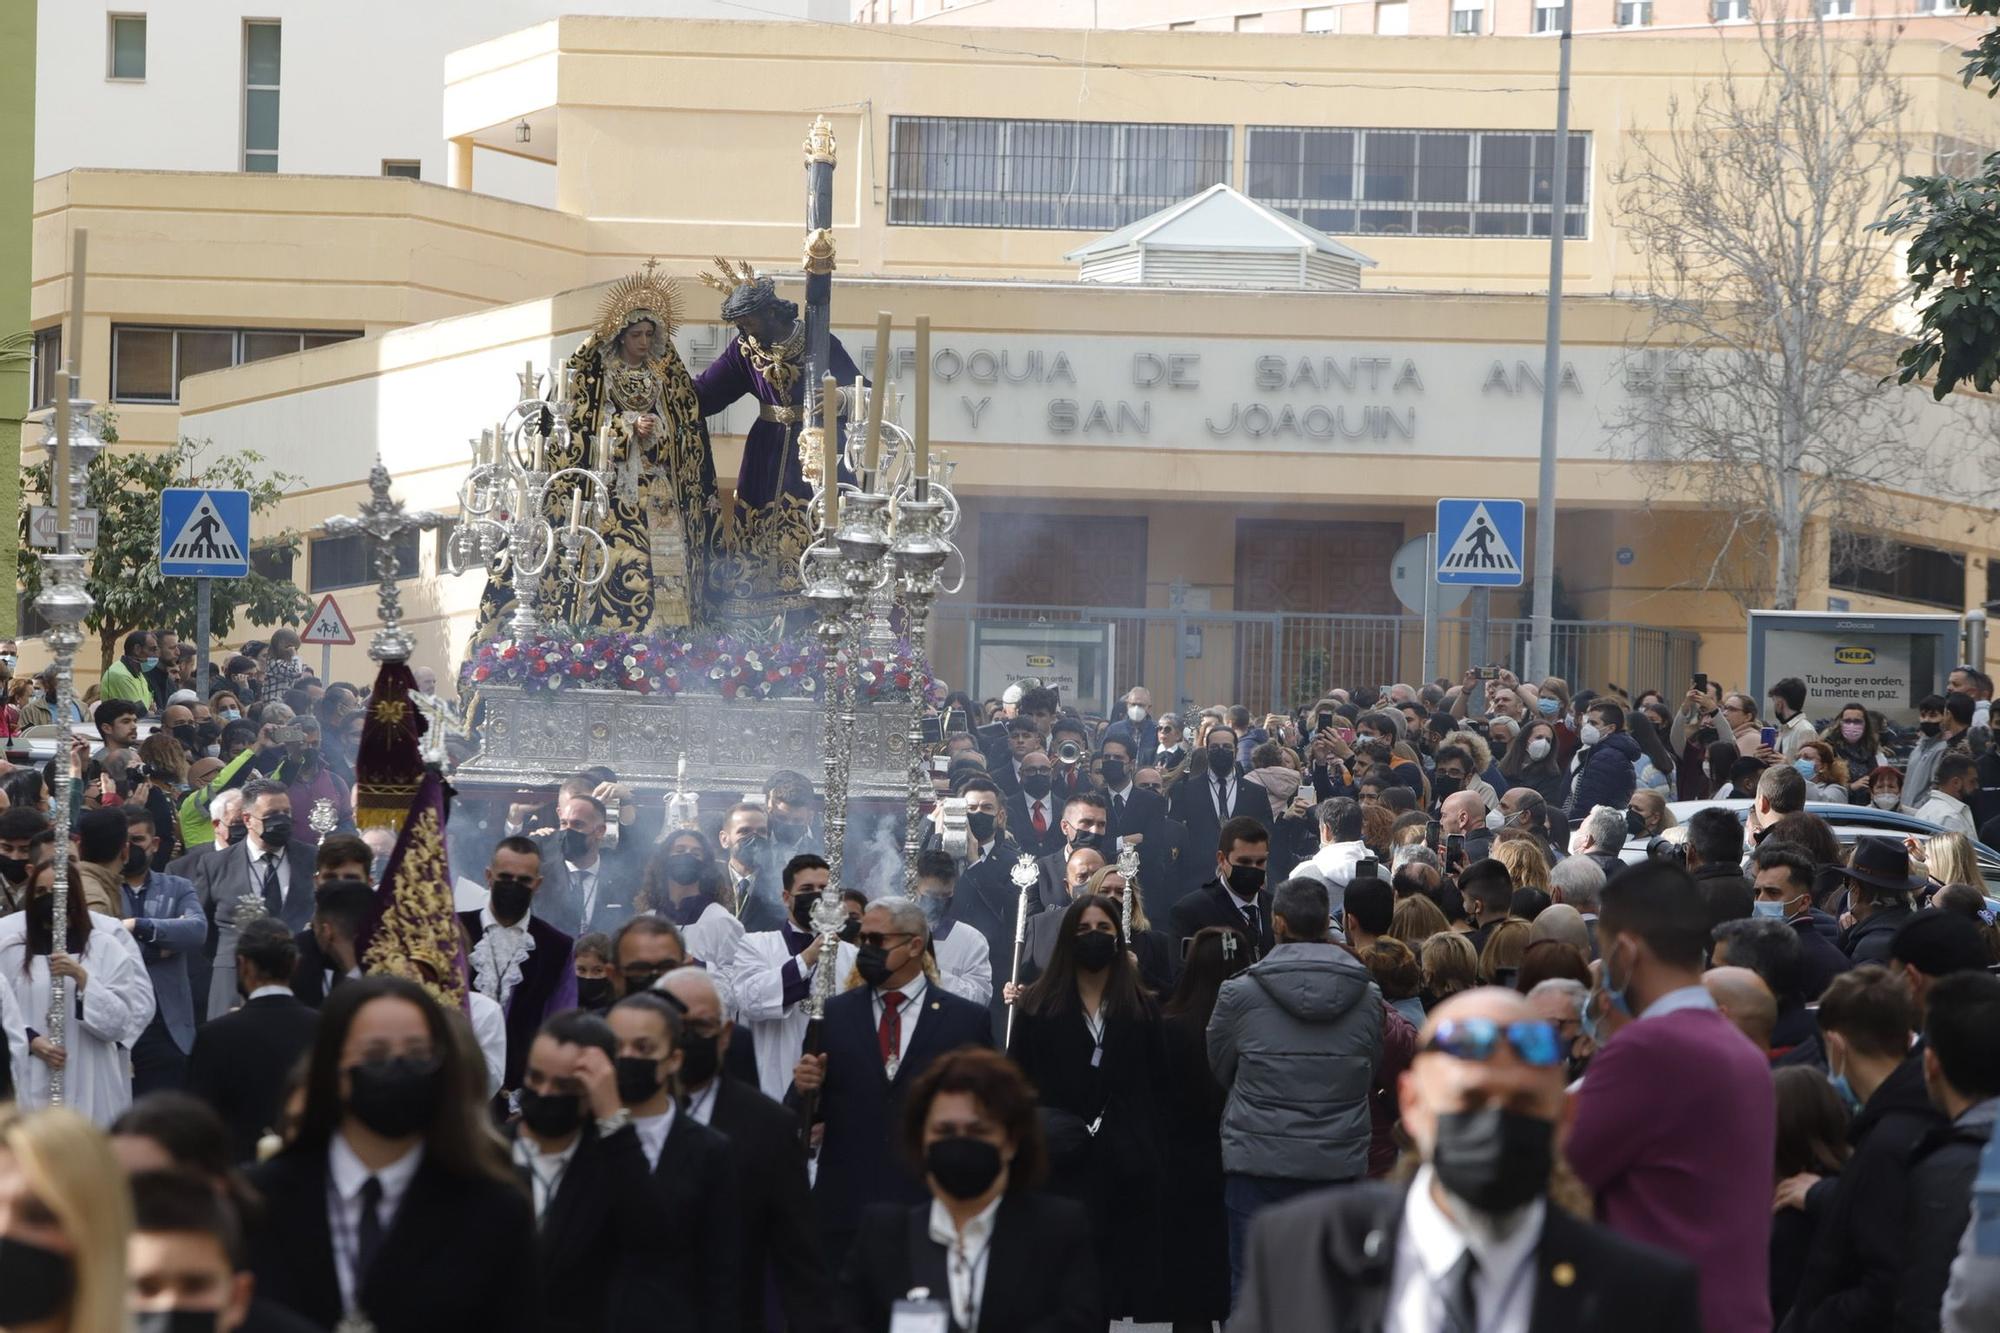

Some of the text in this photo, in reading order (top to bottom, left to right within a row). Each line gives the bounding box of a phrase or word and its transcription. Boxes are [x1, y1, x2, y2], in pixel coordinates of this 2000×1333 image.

[1133, 353, 1200, 386] DE
[1254, 355, 1424, 391] SANTA
[1480, 359, 1583, 395] ANA
[961, 396, 1415, 440] Y SAN JOAQUIN
[1805, 675, 1818, 684] Tu
[1820, 674, 1852, 687] hogar
[1870, 676, 1904, 686] orden,
[1811, 688, 1900, 700] tu mente en paz.
